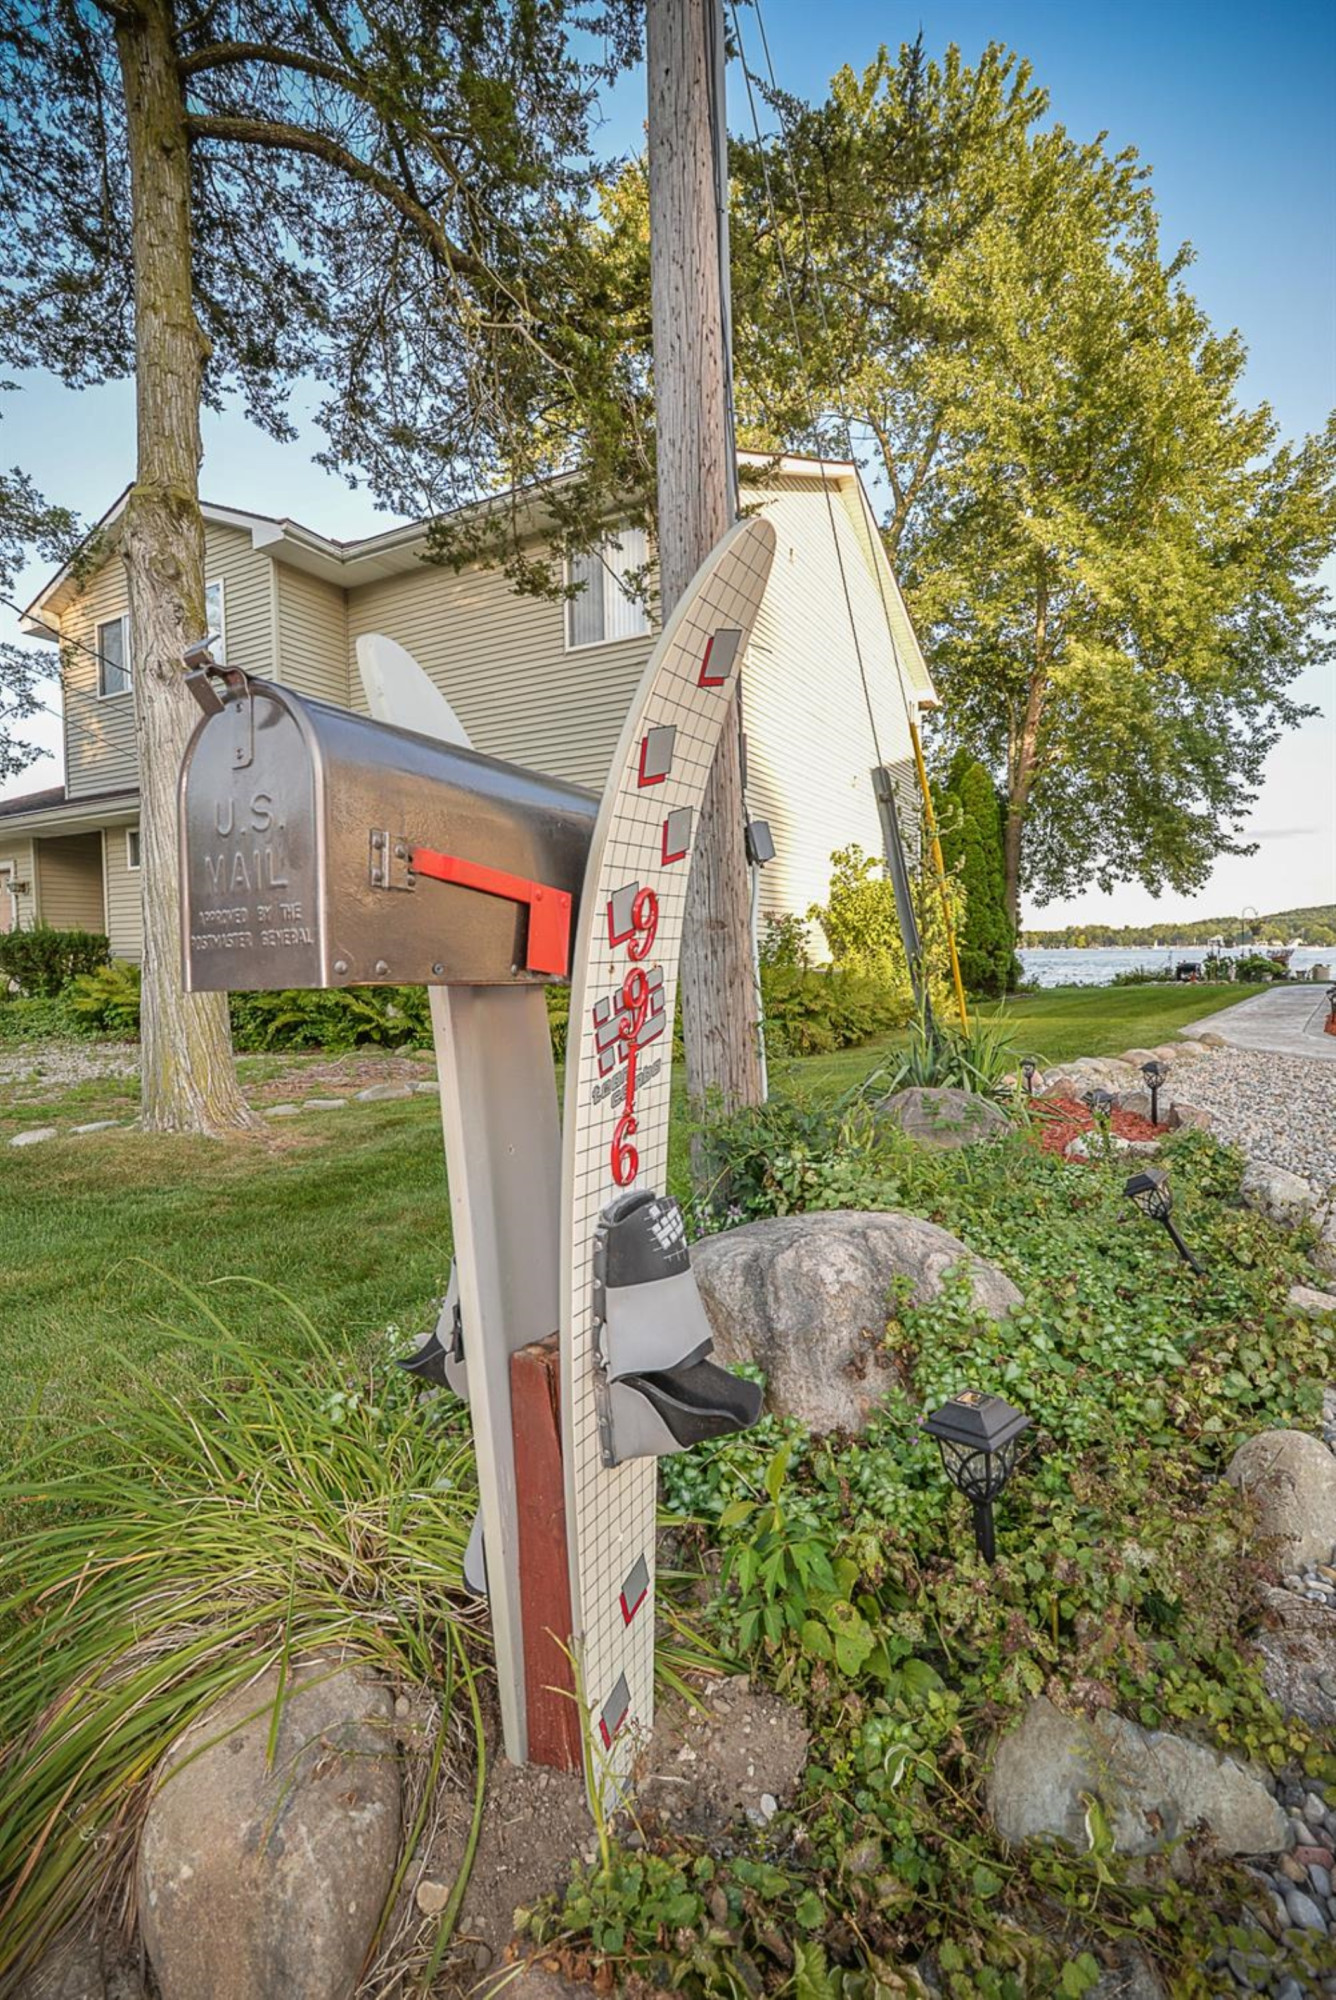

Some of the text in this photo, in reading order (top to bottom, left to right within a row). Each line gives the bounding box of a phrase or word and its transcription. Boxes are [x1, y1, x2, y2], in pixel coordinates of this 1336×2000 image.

[214, 793, 285, 838] U.S.
[204, 848, 289, 894] MAIL
[257, 904, 273, 923] BY
[279, 902, 303, 921] THE
